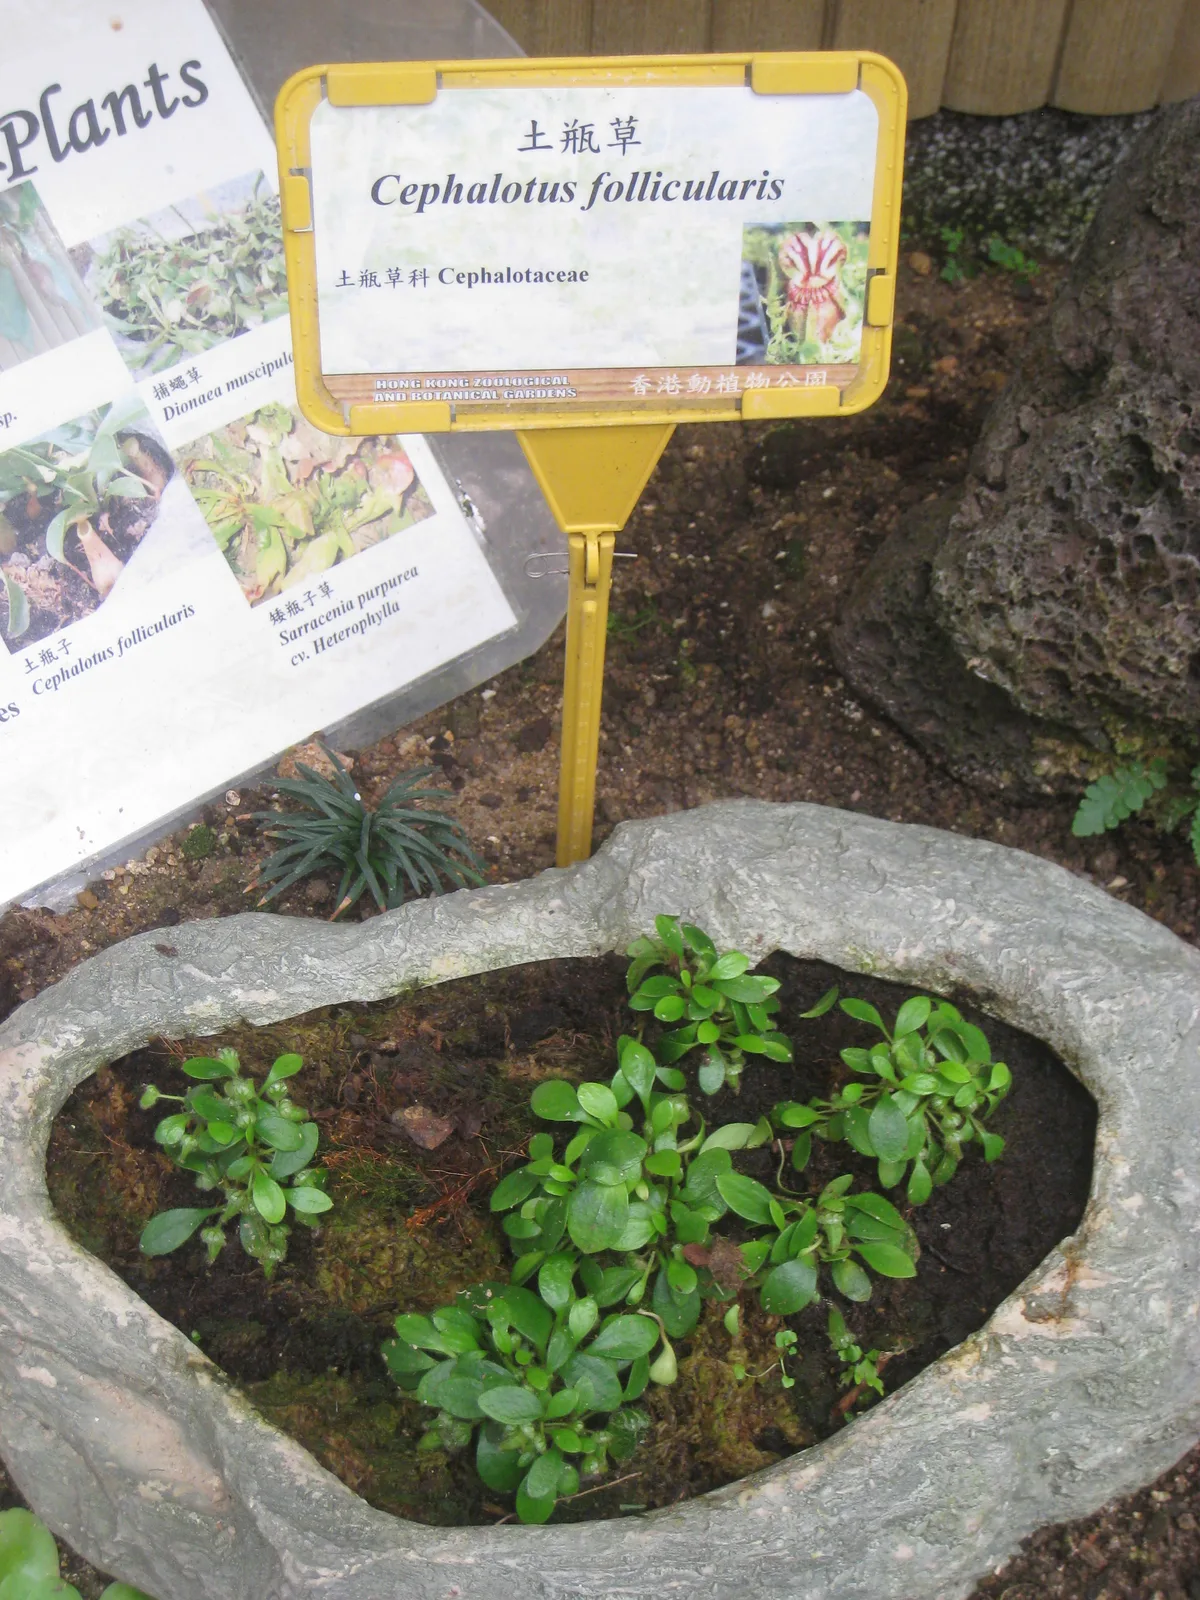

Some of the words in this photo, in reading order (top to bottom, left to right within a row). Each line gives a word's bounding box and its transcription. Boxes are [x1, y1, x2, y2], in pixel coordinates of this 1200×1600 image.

[0, 60, 209, 183] Plants
[517, 115, 642, 156] 土瓶草
[370, 172, 578, 213] Cephalotus
[580, 170, 785, 212] follicularis
[335, 266, 431, 289] 土瓶草科
[438, 266, 590, 289] Cephalotaceae
[152, 366, 203, 401] 捕蠅草
[374, 391, 408, 402] AND
[411, 389, 500, 400] BOTANICAL
[503, 388, 578, 399] GARDENS
[375, 379, 421, 389] HONG
[425, 378, 470, 388] KONG
[473, 376, 570, 387] ZOOLOGICAL
[629, 371, 828, 396] 香港動植物公園
[162, 386, 223, 422] Dionaea
[279, 599, 355, 646] Sarracenia
[356, 566, 419, 609] purpurea
[32, 646, 115, 695] Cephalotus
[116, 603, 196, 657] follicularis
[291, 650, 310, 667] cv.
[312, 599, 401, 656] Heterophylla
[24, 638, 72, 675] 土瓶子
